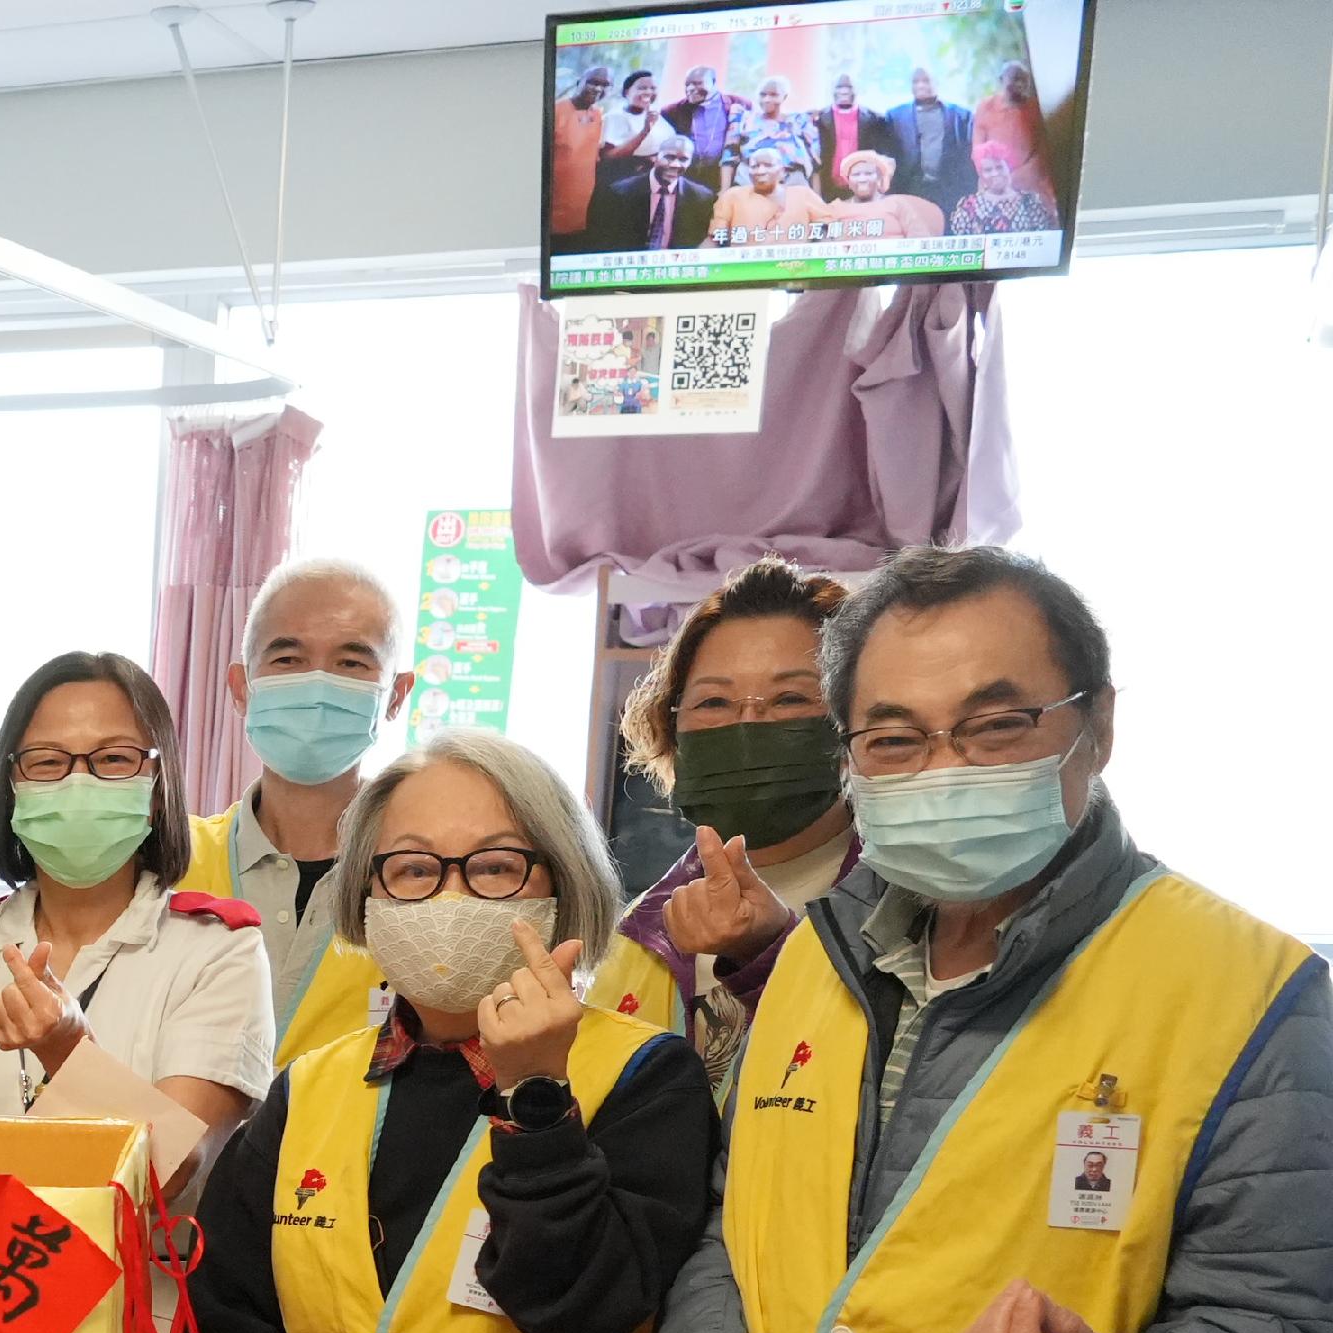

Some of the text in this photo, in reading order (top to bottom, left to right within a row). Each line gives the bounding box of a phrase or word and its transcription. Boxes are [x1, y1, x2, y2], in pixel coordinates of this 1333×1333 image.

[713, 219, 884, 244] 年過七十的瓦庫米爾
[1077, 1124, 1120, 1140] 義工
